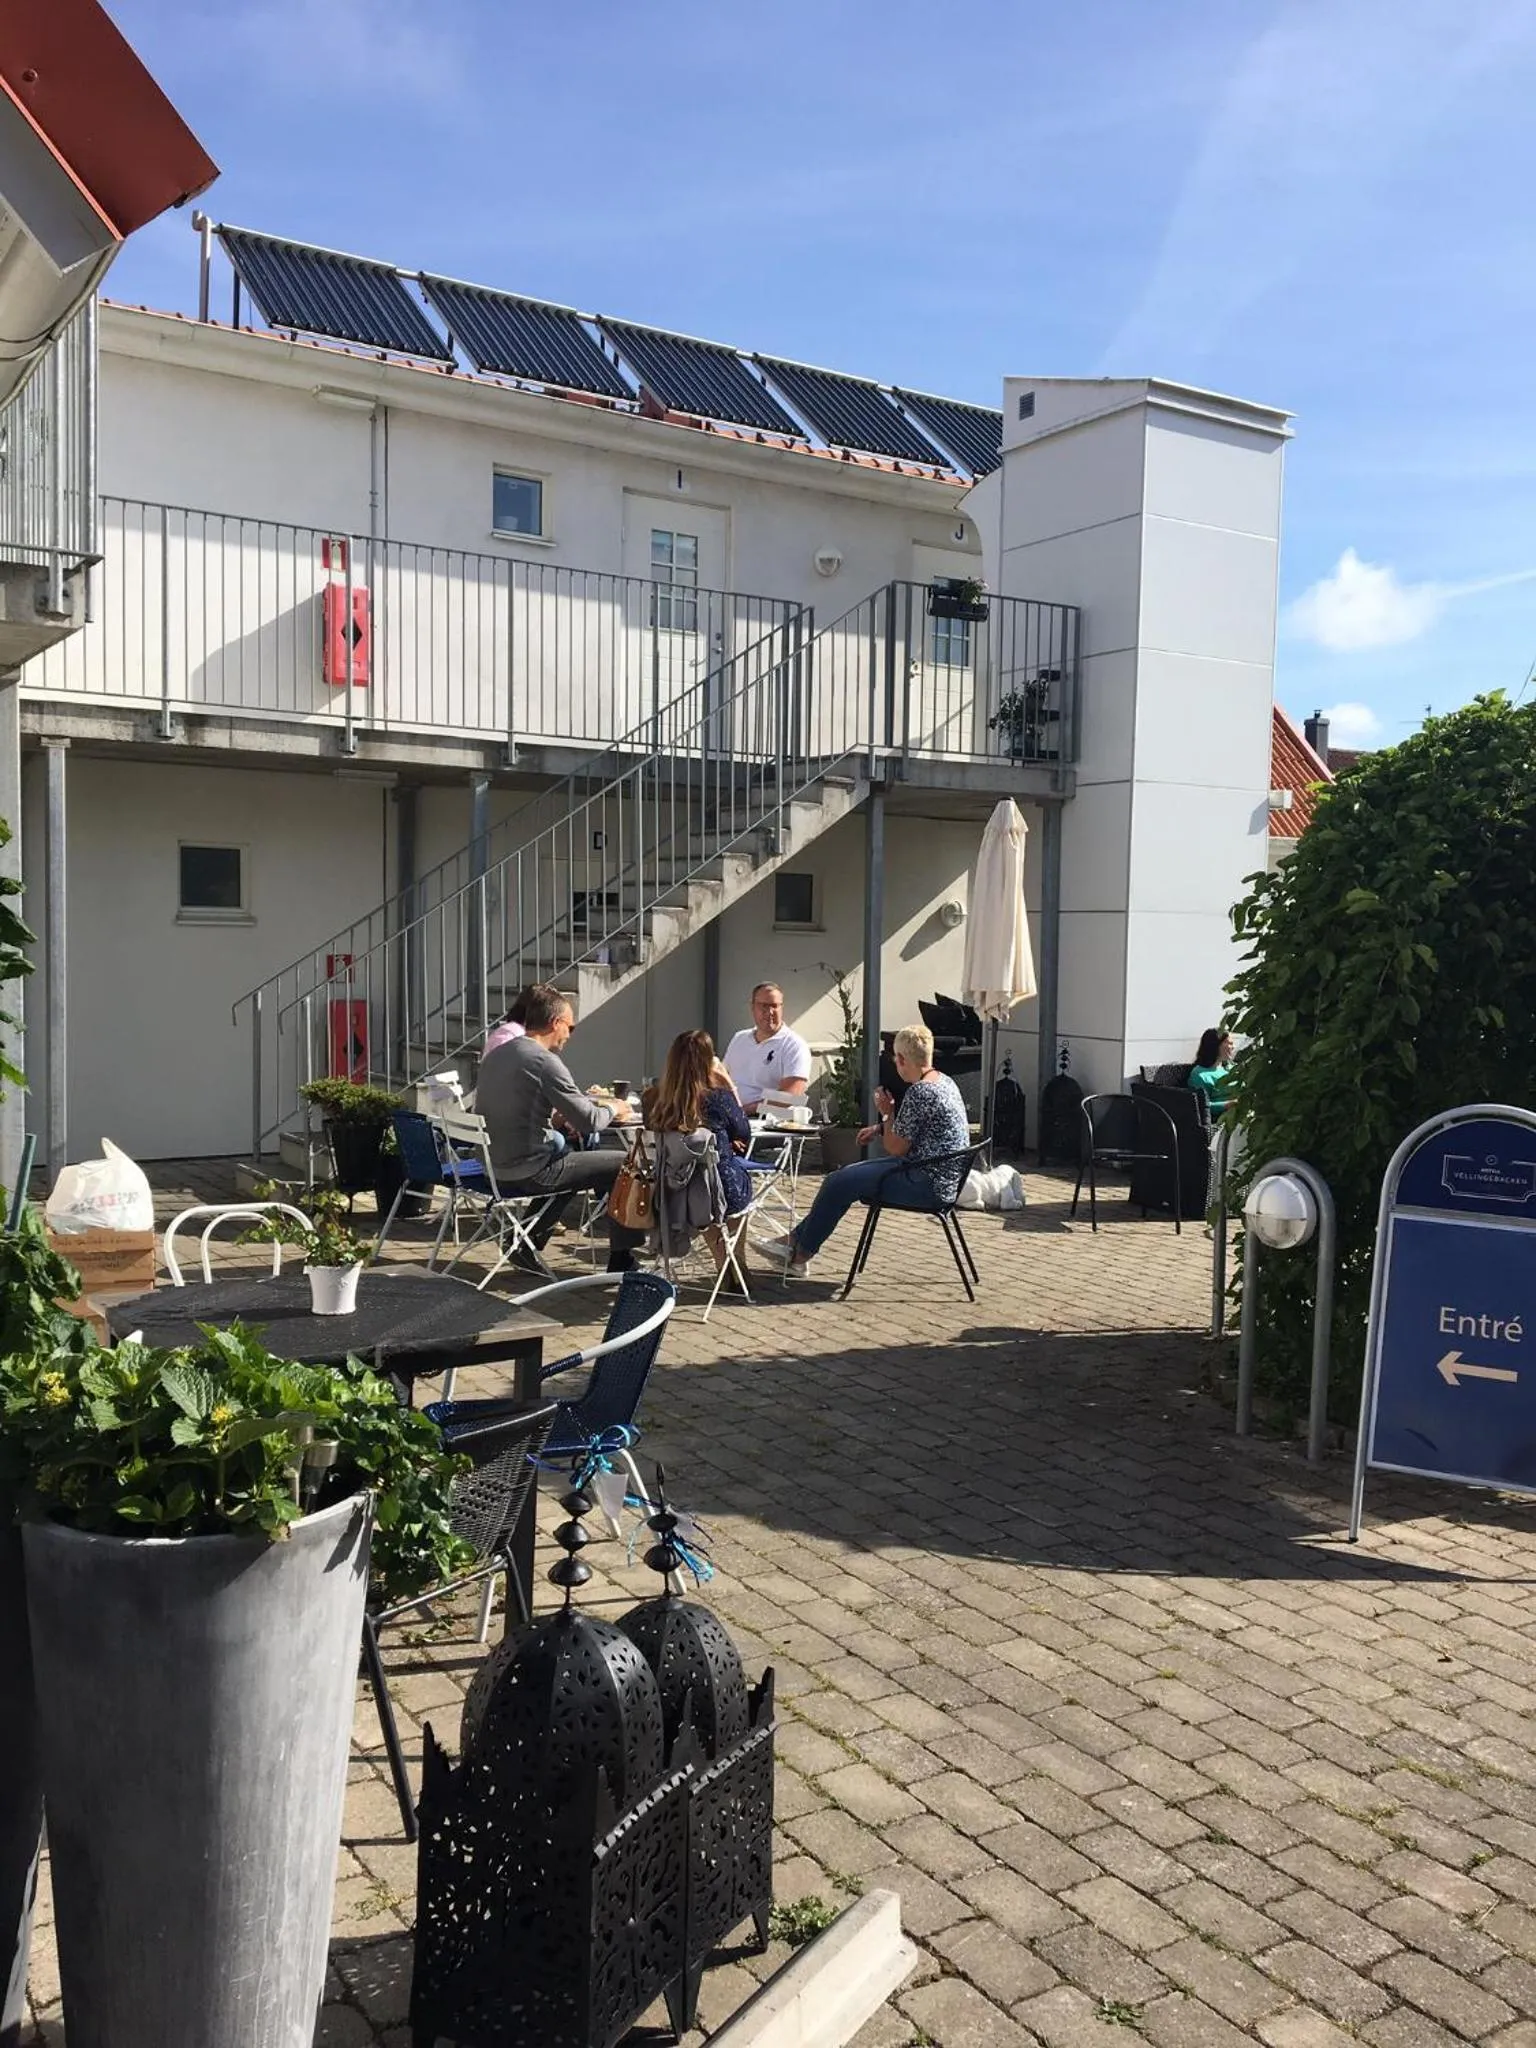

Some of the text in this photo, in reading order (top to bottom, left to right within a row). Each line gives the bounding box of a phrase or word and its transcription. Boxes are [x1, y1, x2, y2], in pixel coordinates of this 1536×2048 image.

[954, 523, 964, 541] J
[593, 831, 608, 850] D
[1439, 1305, 1523, 1343] Entré
